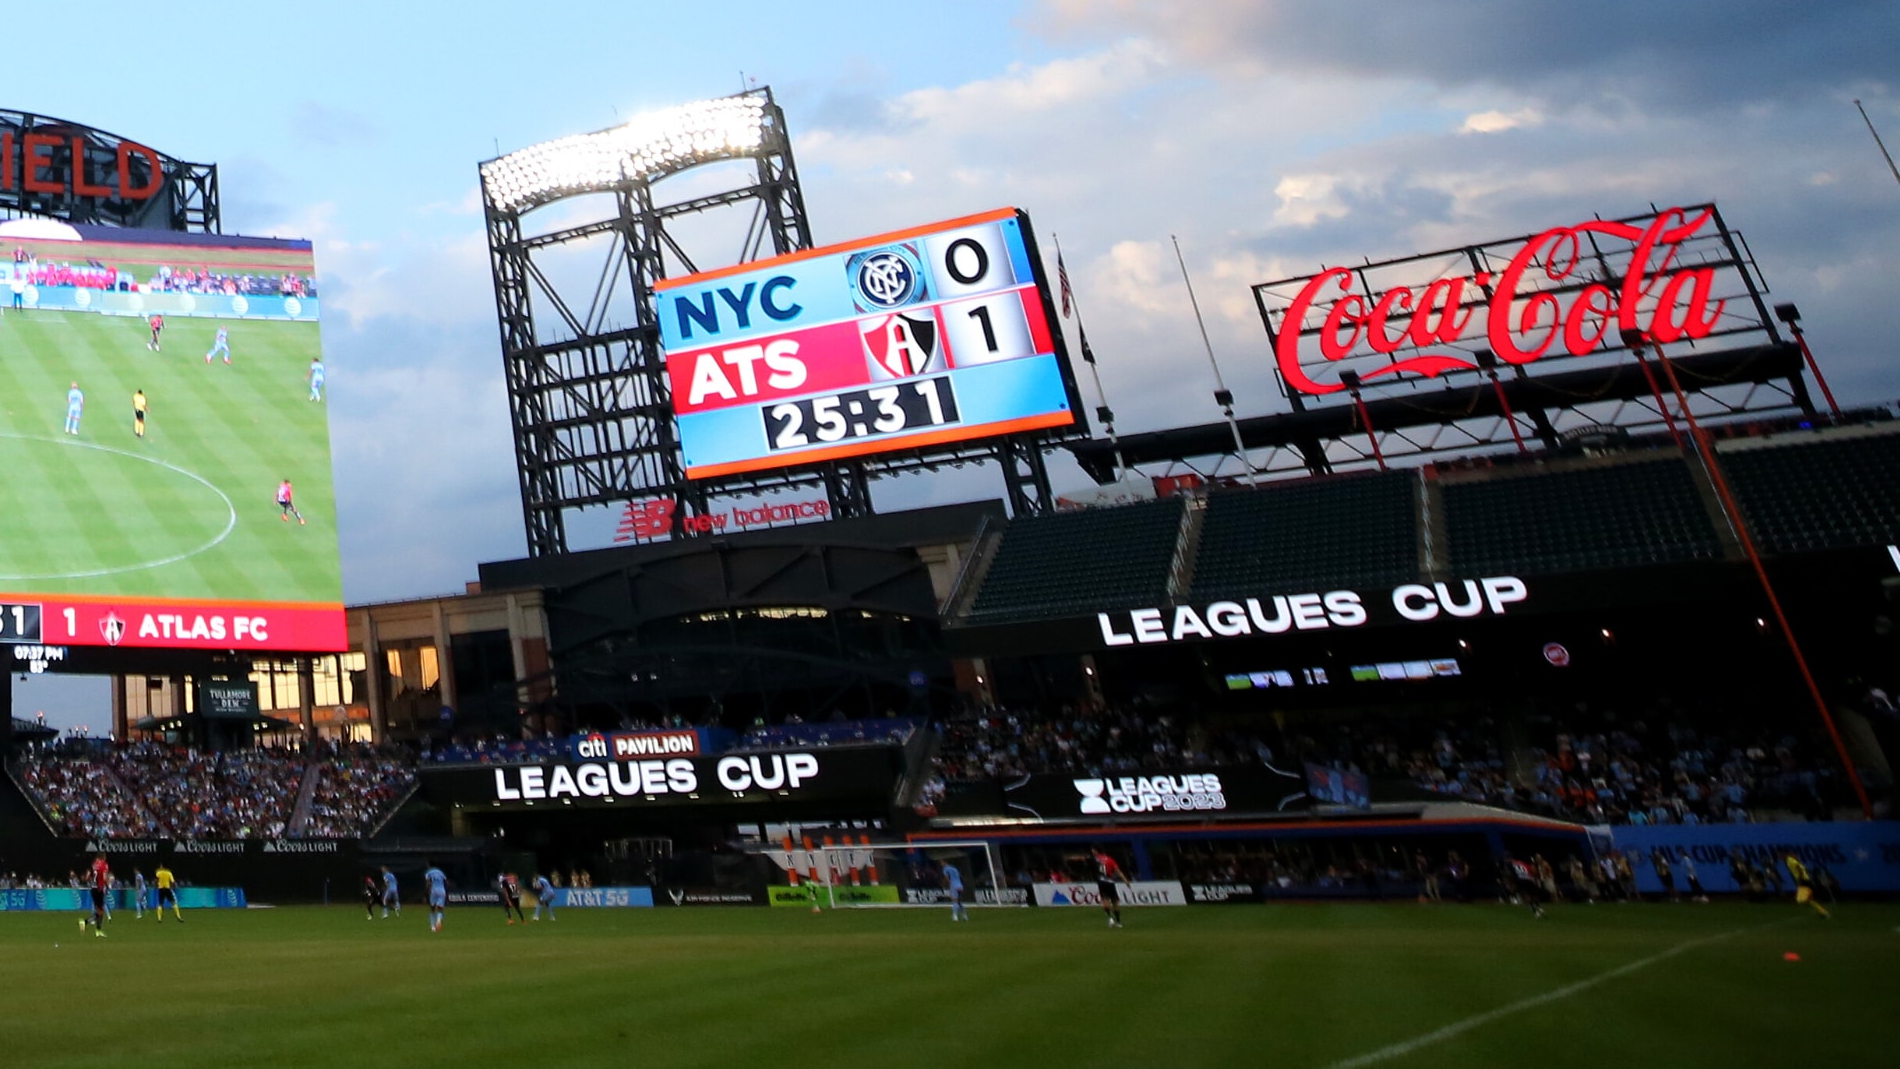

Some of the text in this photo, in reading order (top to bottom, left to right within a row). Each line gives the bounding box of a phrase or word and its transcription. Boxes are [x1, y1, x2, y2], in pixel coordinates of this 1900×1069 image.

[945, 237, 989, 285] 0
[674, 275, 804, 340] NYC
[967, 305, 998, 355] 1
[688, 340, 807, 404] ATS
[772, 382, 947, 448] 25:31
[683, 511, 728, 533] new
[732, 499, 831, 527] balance
[63, 607, 76, 637] 1
[1098, 576, 1527, 646] LEAGUES CUP
[138, 614, 268, 642] ATLAS FC
[45, 646, 63, 661] PM
[615, 735, 694, 756] PAVILION
[495, 753, 819, 799] LEAGUES CUP
[1105, 773, 1222, 796] LEAGUES
[1110, 792, 1227, 813] CUP 2023
[129, 842, 158, 854] LIGHT
[217, 842, 245, 854] LIGHT
[308, 842, 338, 853] LIGHT
[1692, 844, 1727, 865] CUP
[567, 888, 603, 907] AT&T
[1122, 886, 1169, 899] LIGHT
